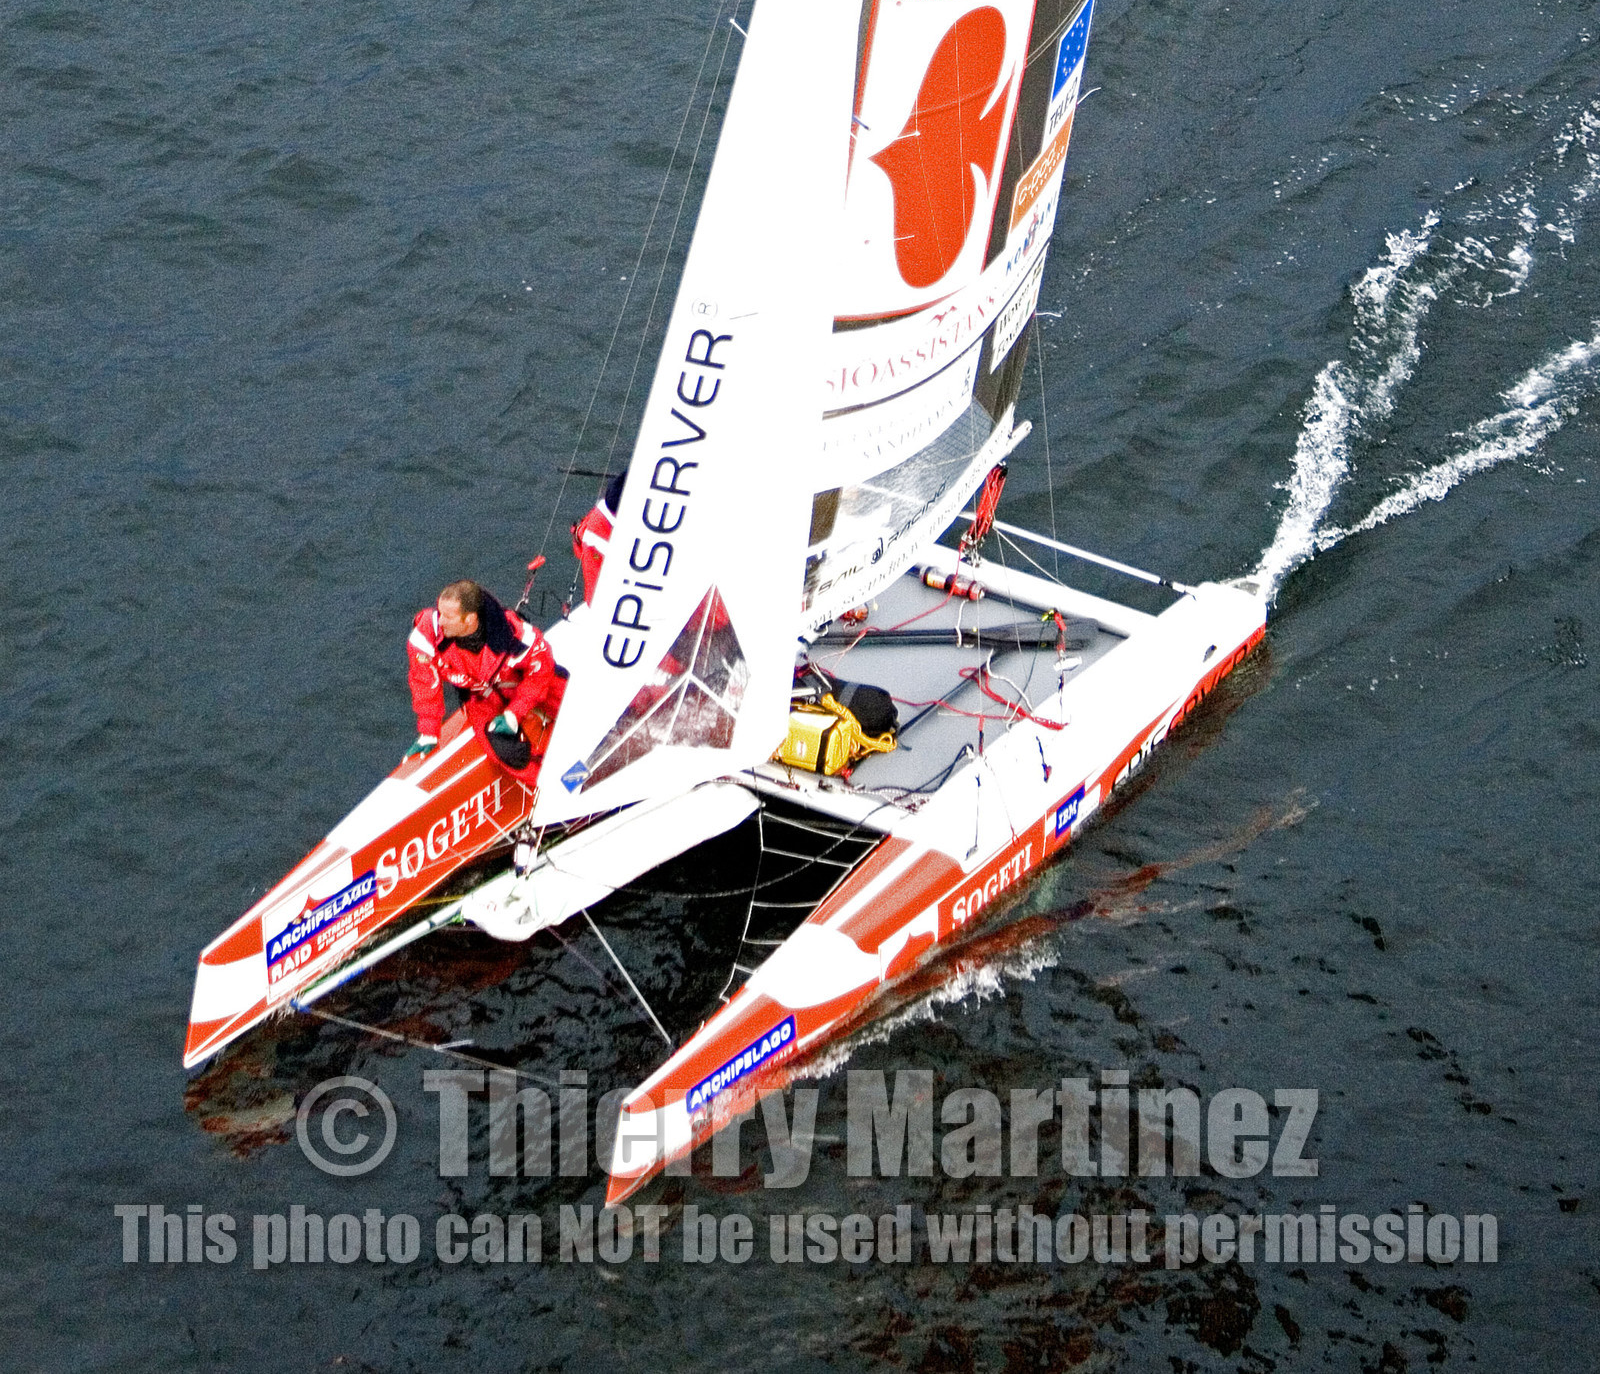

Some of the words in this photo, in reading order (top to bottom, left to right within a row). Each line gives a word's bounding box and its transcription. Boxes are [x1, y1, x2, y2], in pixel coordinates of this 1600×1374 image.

[376, 777, 505, 899] SOGETI
[1058, 798, 1078, 827] IBM
[270, 876, 375, 961] ARCHIPELAGO
[951, 842, 1034, 930] SOGETI
[271, 943, 313, 985] RAID
[690, 1022, 792, 1110] ARCHIPELAGO
